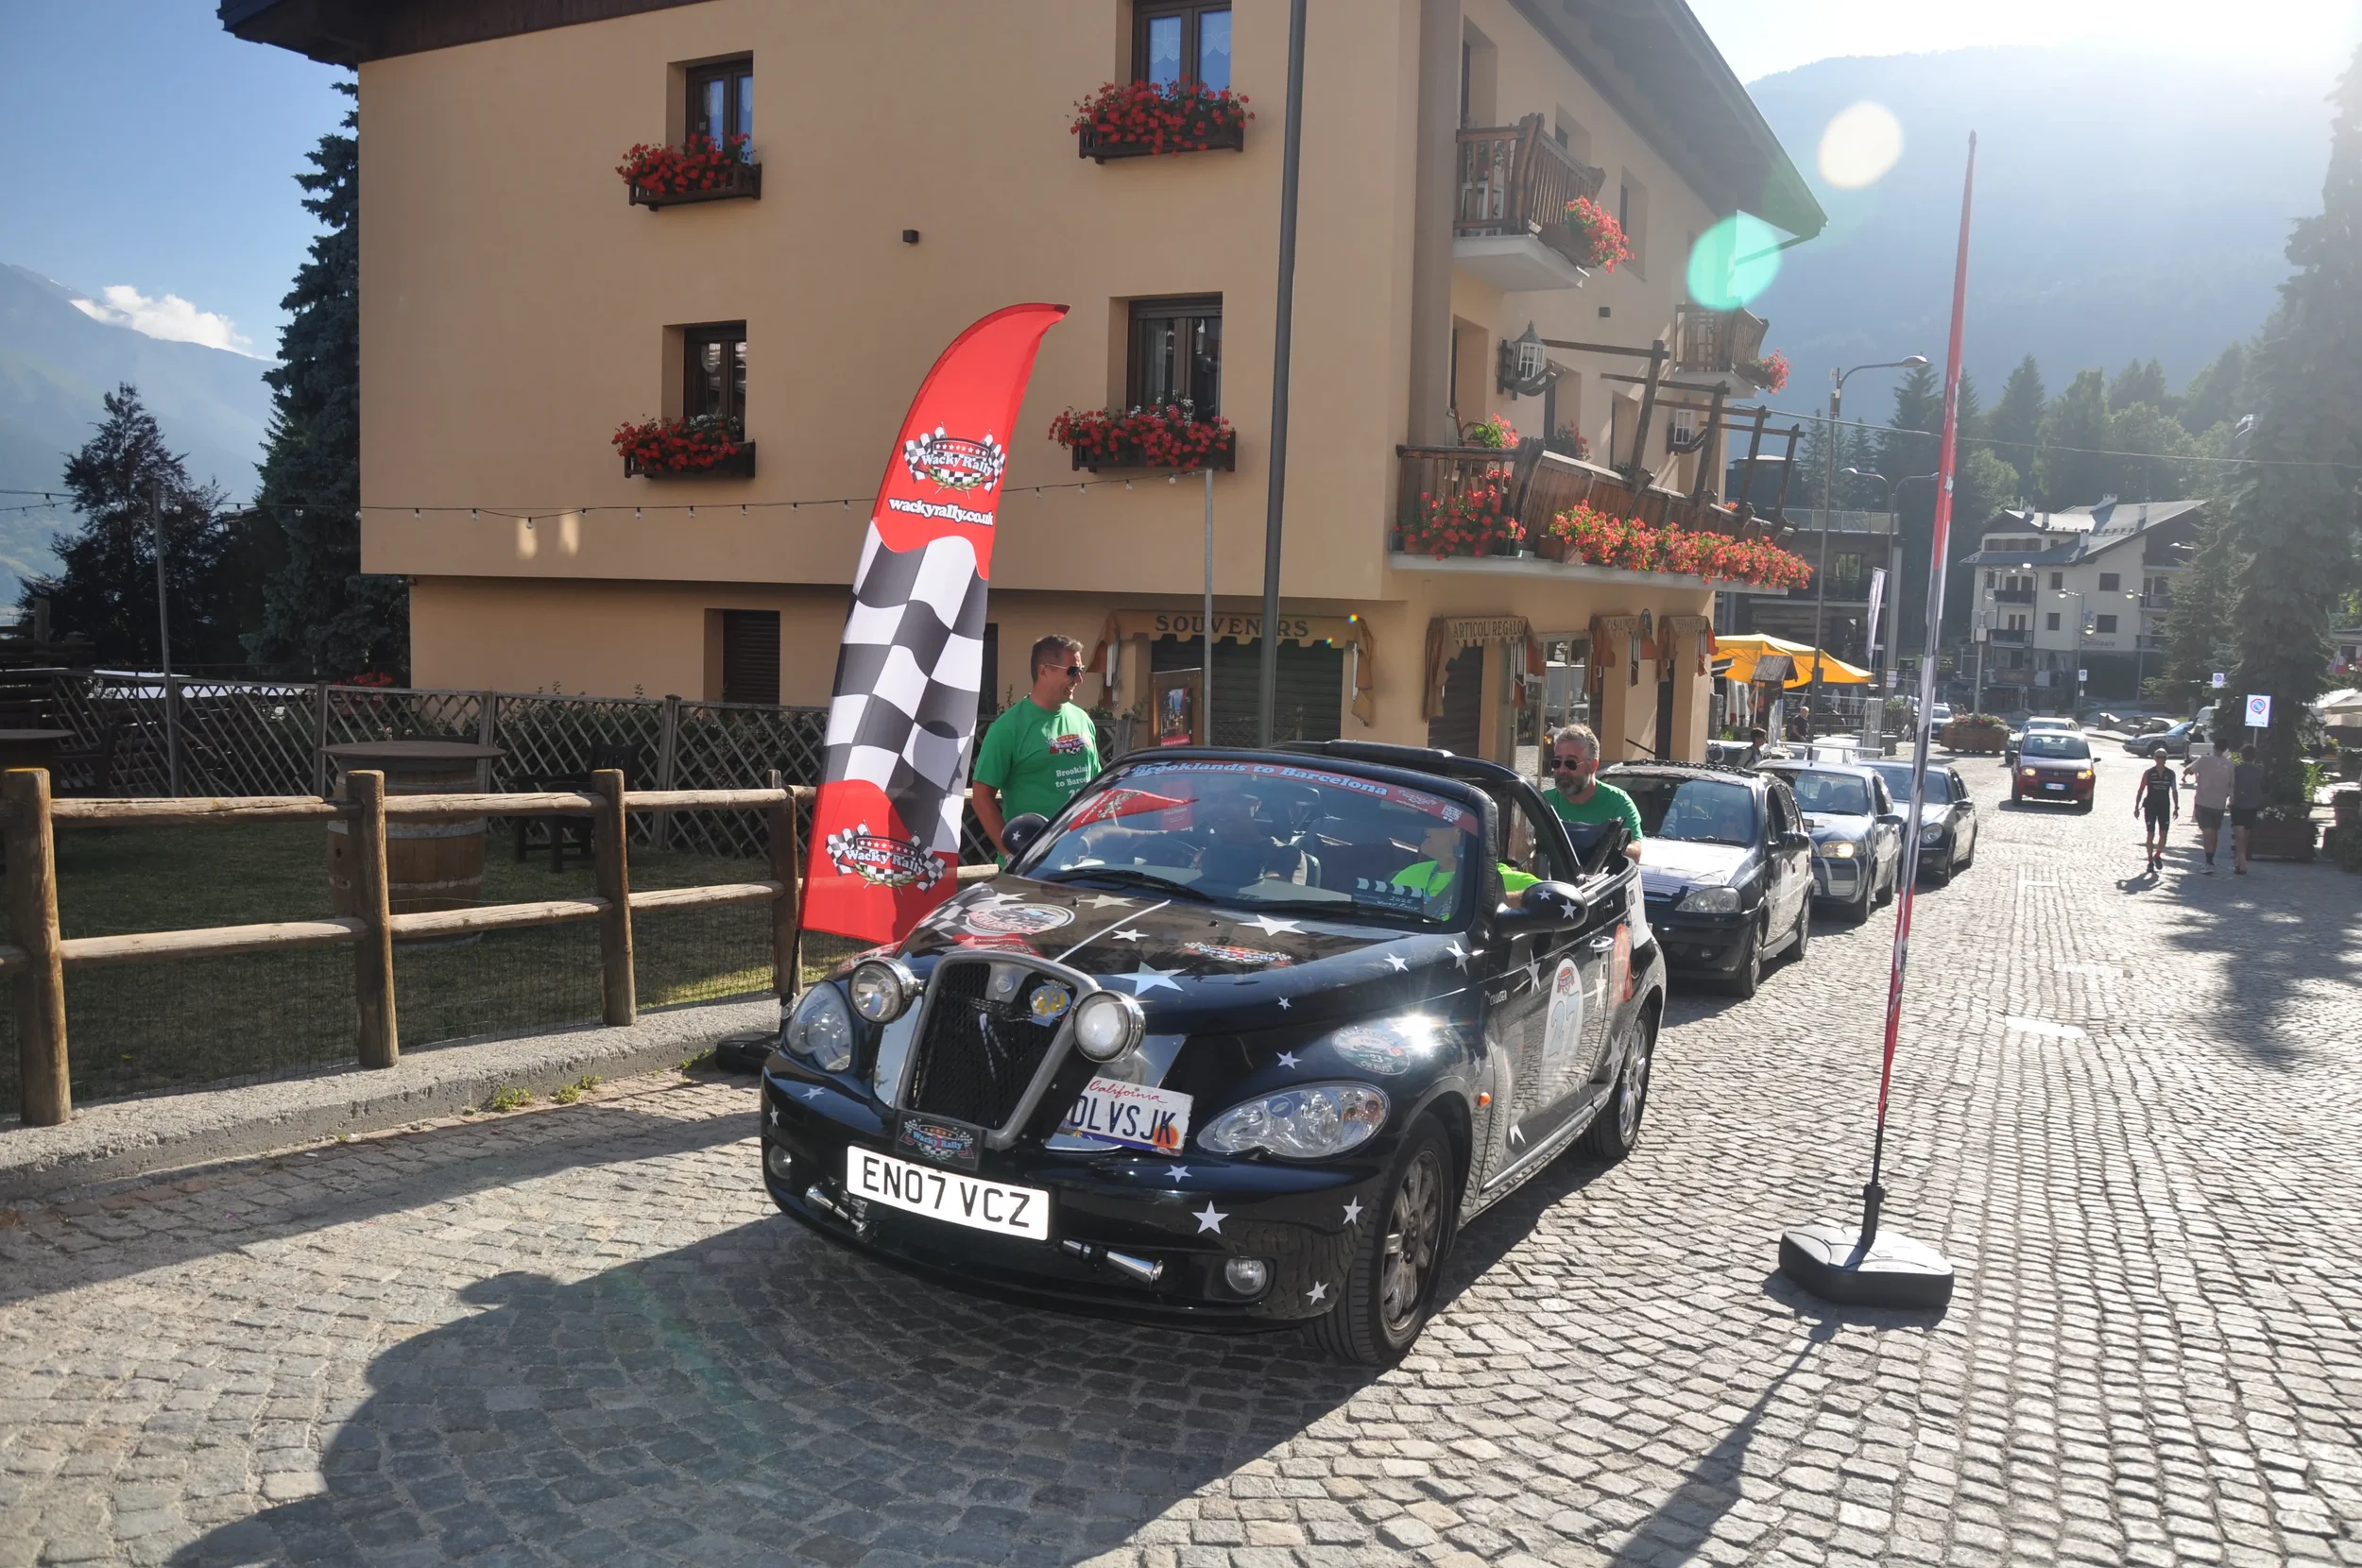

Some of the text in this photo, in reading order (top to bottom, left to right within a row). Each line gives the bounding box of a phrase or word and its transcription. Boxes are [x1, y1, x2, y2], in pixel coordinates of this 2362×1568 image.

[921, 454, 993, 476] Wacky Rally
[888, 498, 993, 526] wackyrally.co.uk
[1155, 615, 1309, 638] SOUVENRS
[1452, 620, 1523, 638] ARTICOLI REGALO
[1133, 762, 1247, 775] Brooklands
[1253, 764, 1275, 774] to
[1279, 767, 1388, 796] Barcelona
[845, 849, 925, 875] Wacky Rally
[1548, 990, 1580, 1059] 27
[1088, 1080, 1168, 1103] California
[913, 1130, 963, 1150] Wacky Rally
[864, 1156, 1031, 1229] EN07 VCZ
